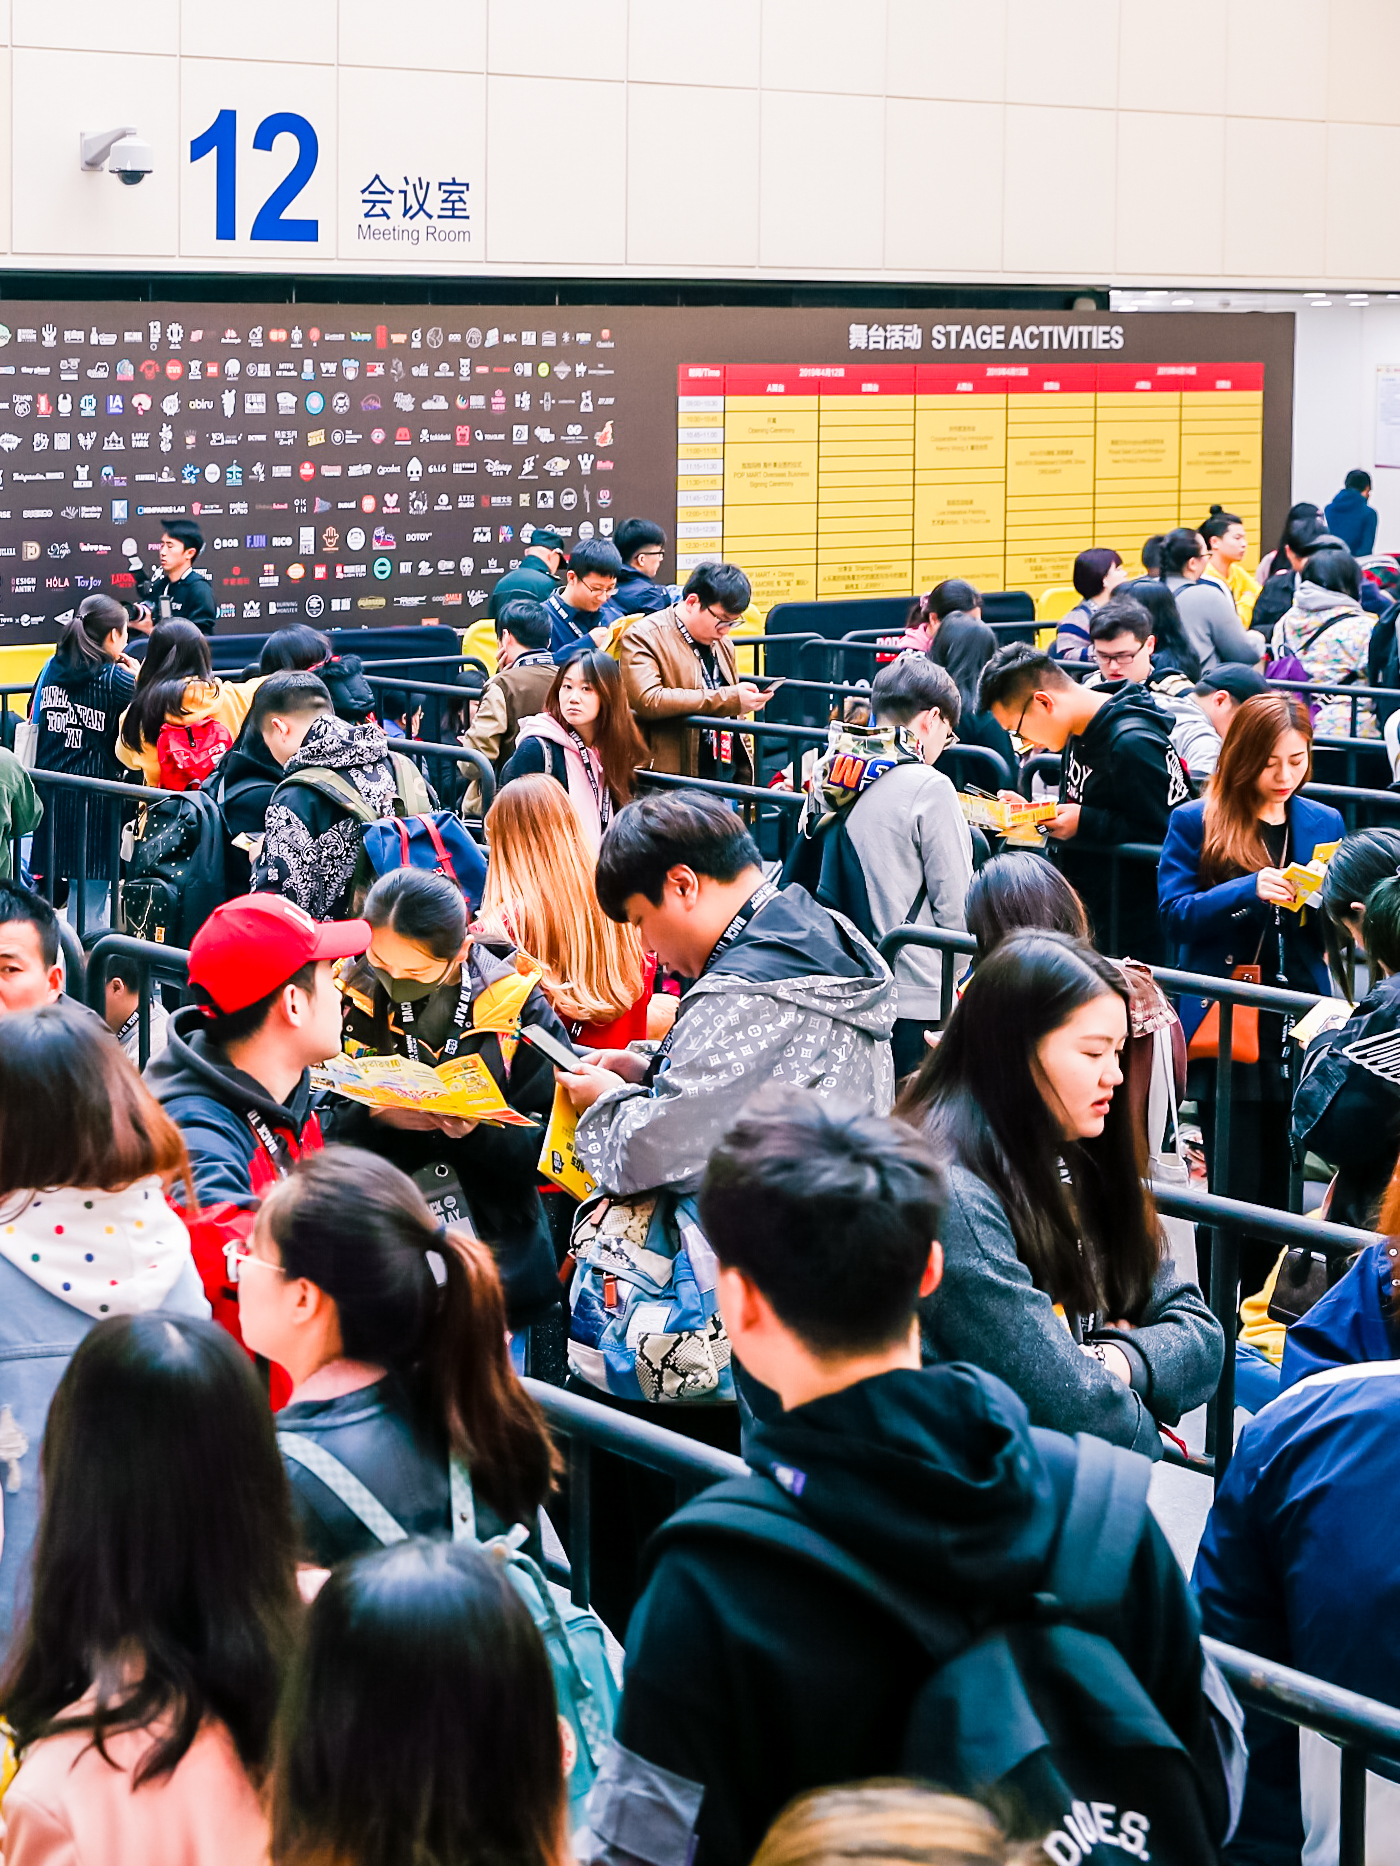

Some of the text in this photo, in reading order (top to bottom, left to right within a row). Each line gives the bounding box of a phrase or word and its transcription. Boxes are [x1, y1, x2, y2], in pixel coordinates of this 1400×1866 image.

[190, 108, 319, 242] 12
[360, 174, 471, 221] 会议室
[357, 224, 471, 245] Meeting Room
[849, 324, 1125, 350] 舞台活动 STAGE ACTIVITIES
[483, 458, 513, 474] Disney
[222, 538, 239, 548] BOB
[11, 577, 36, 586] DESIGN
[11, 585, 36, 593] PANTRY
[445, 592, 462, 602] SMILE
[276, 606, 298, 614] MONSTER
[723, 915, 748, 941] BACK
[453, 1000, 469, 1028] PLAY
[257, 1123, 278, 1155] BACK
